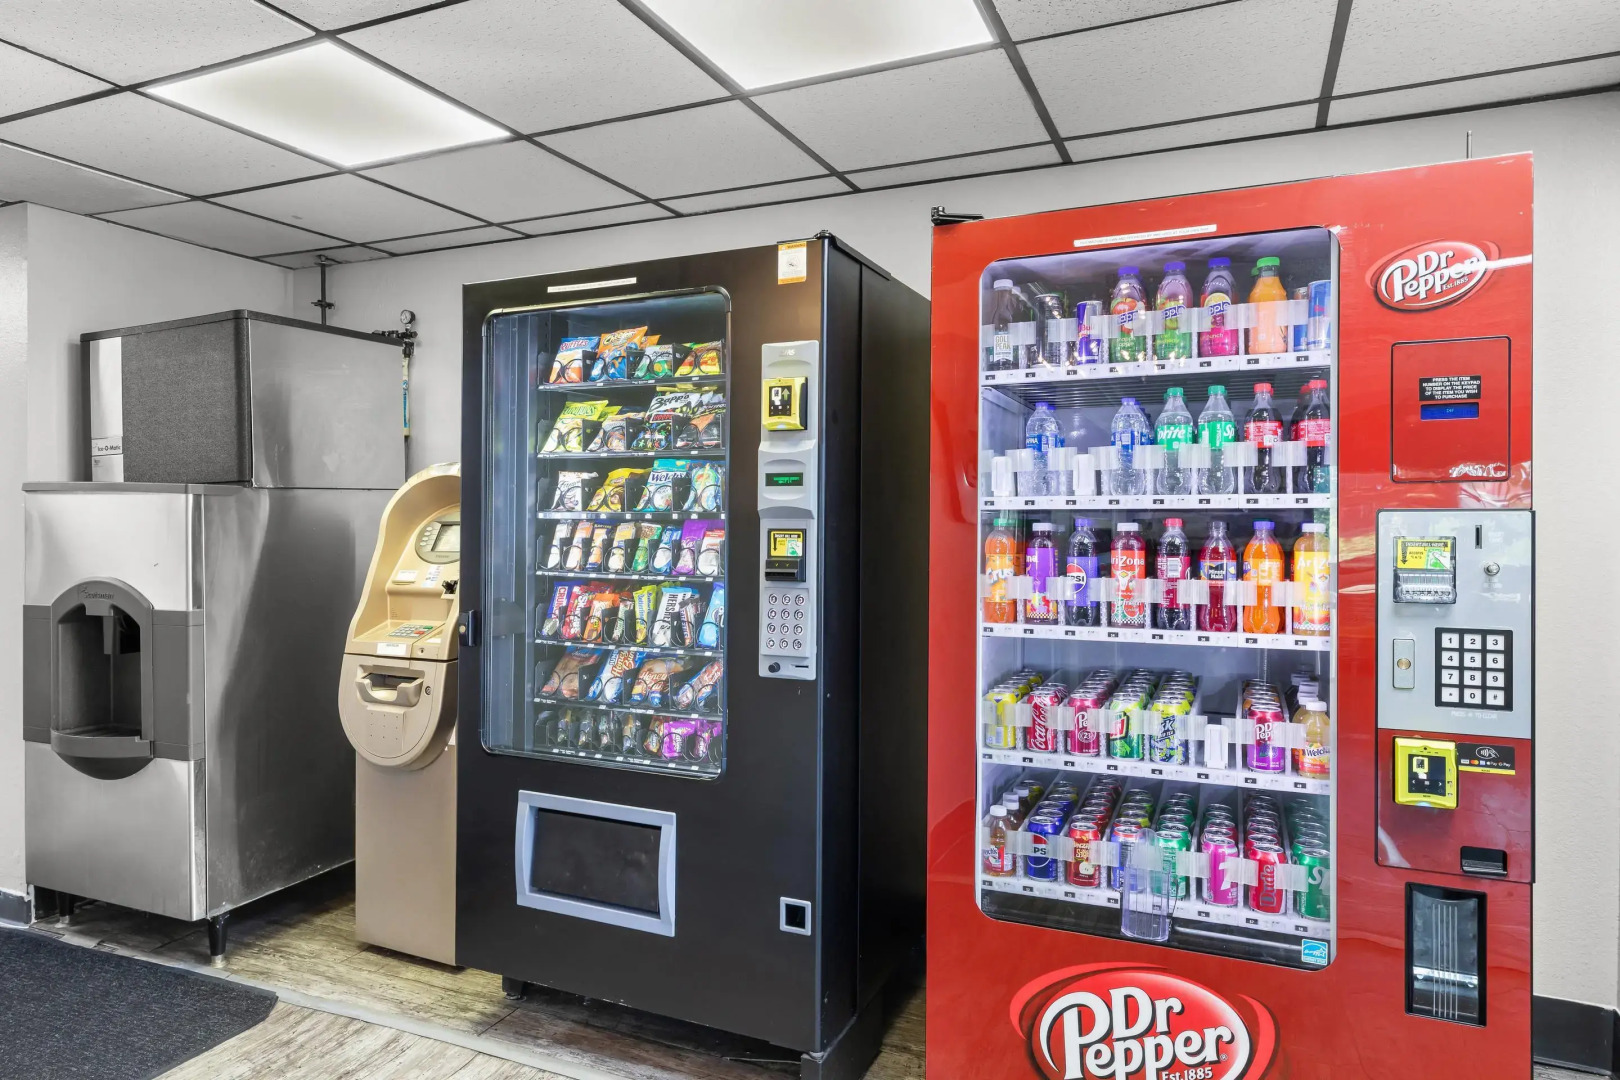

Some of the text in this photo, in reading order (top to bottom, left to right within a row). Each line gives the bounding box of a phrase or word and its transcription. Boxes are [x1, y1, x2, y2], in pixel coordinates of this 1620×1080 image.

[1380, 256, 1480, 302] Pepper
[1416, 250, 1455, 277] Dr
[995, 342, 1011, 350] PEAK
[1039, 991, 1235, 1080] Pepper
[1108, 985, 1184, 1040] Dr
